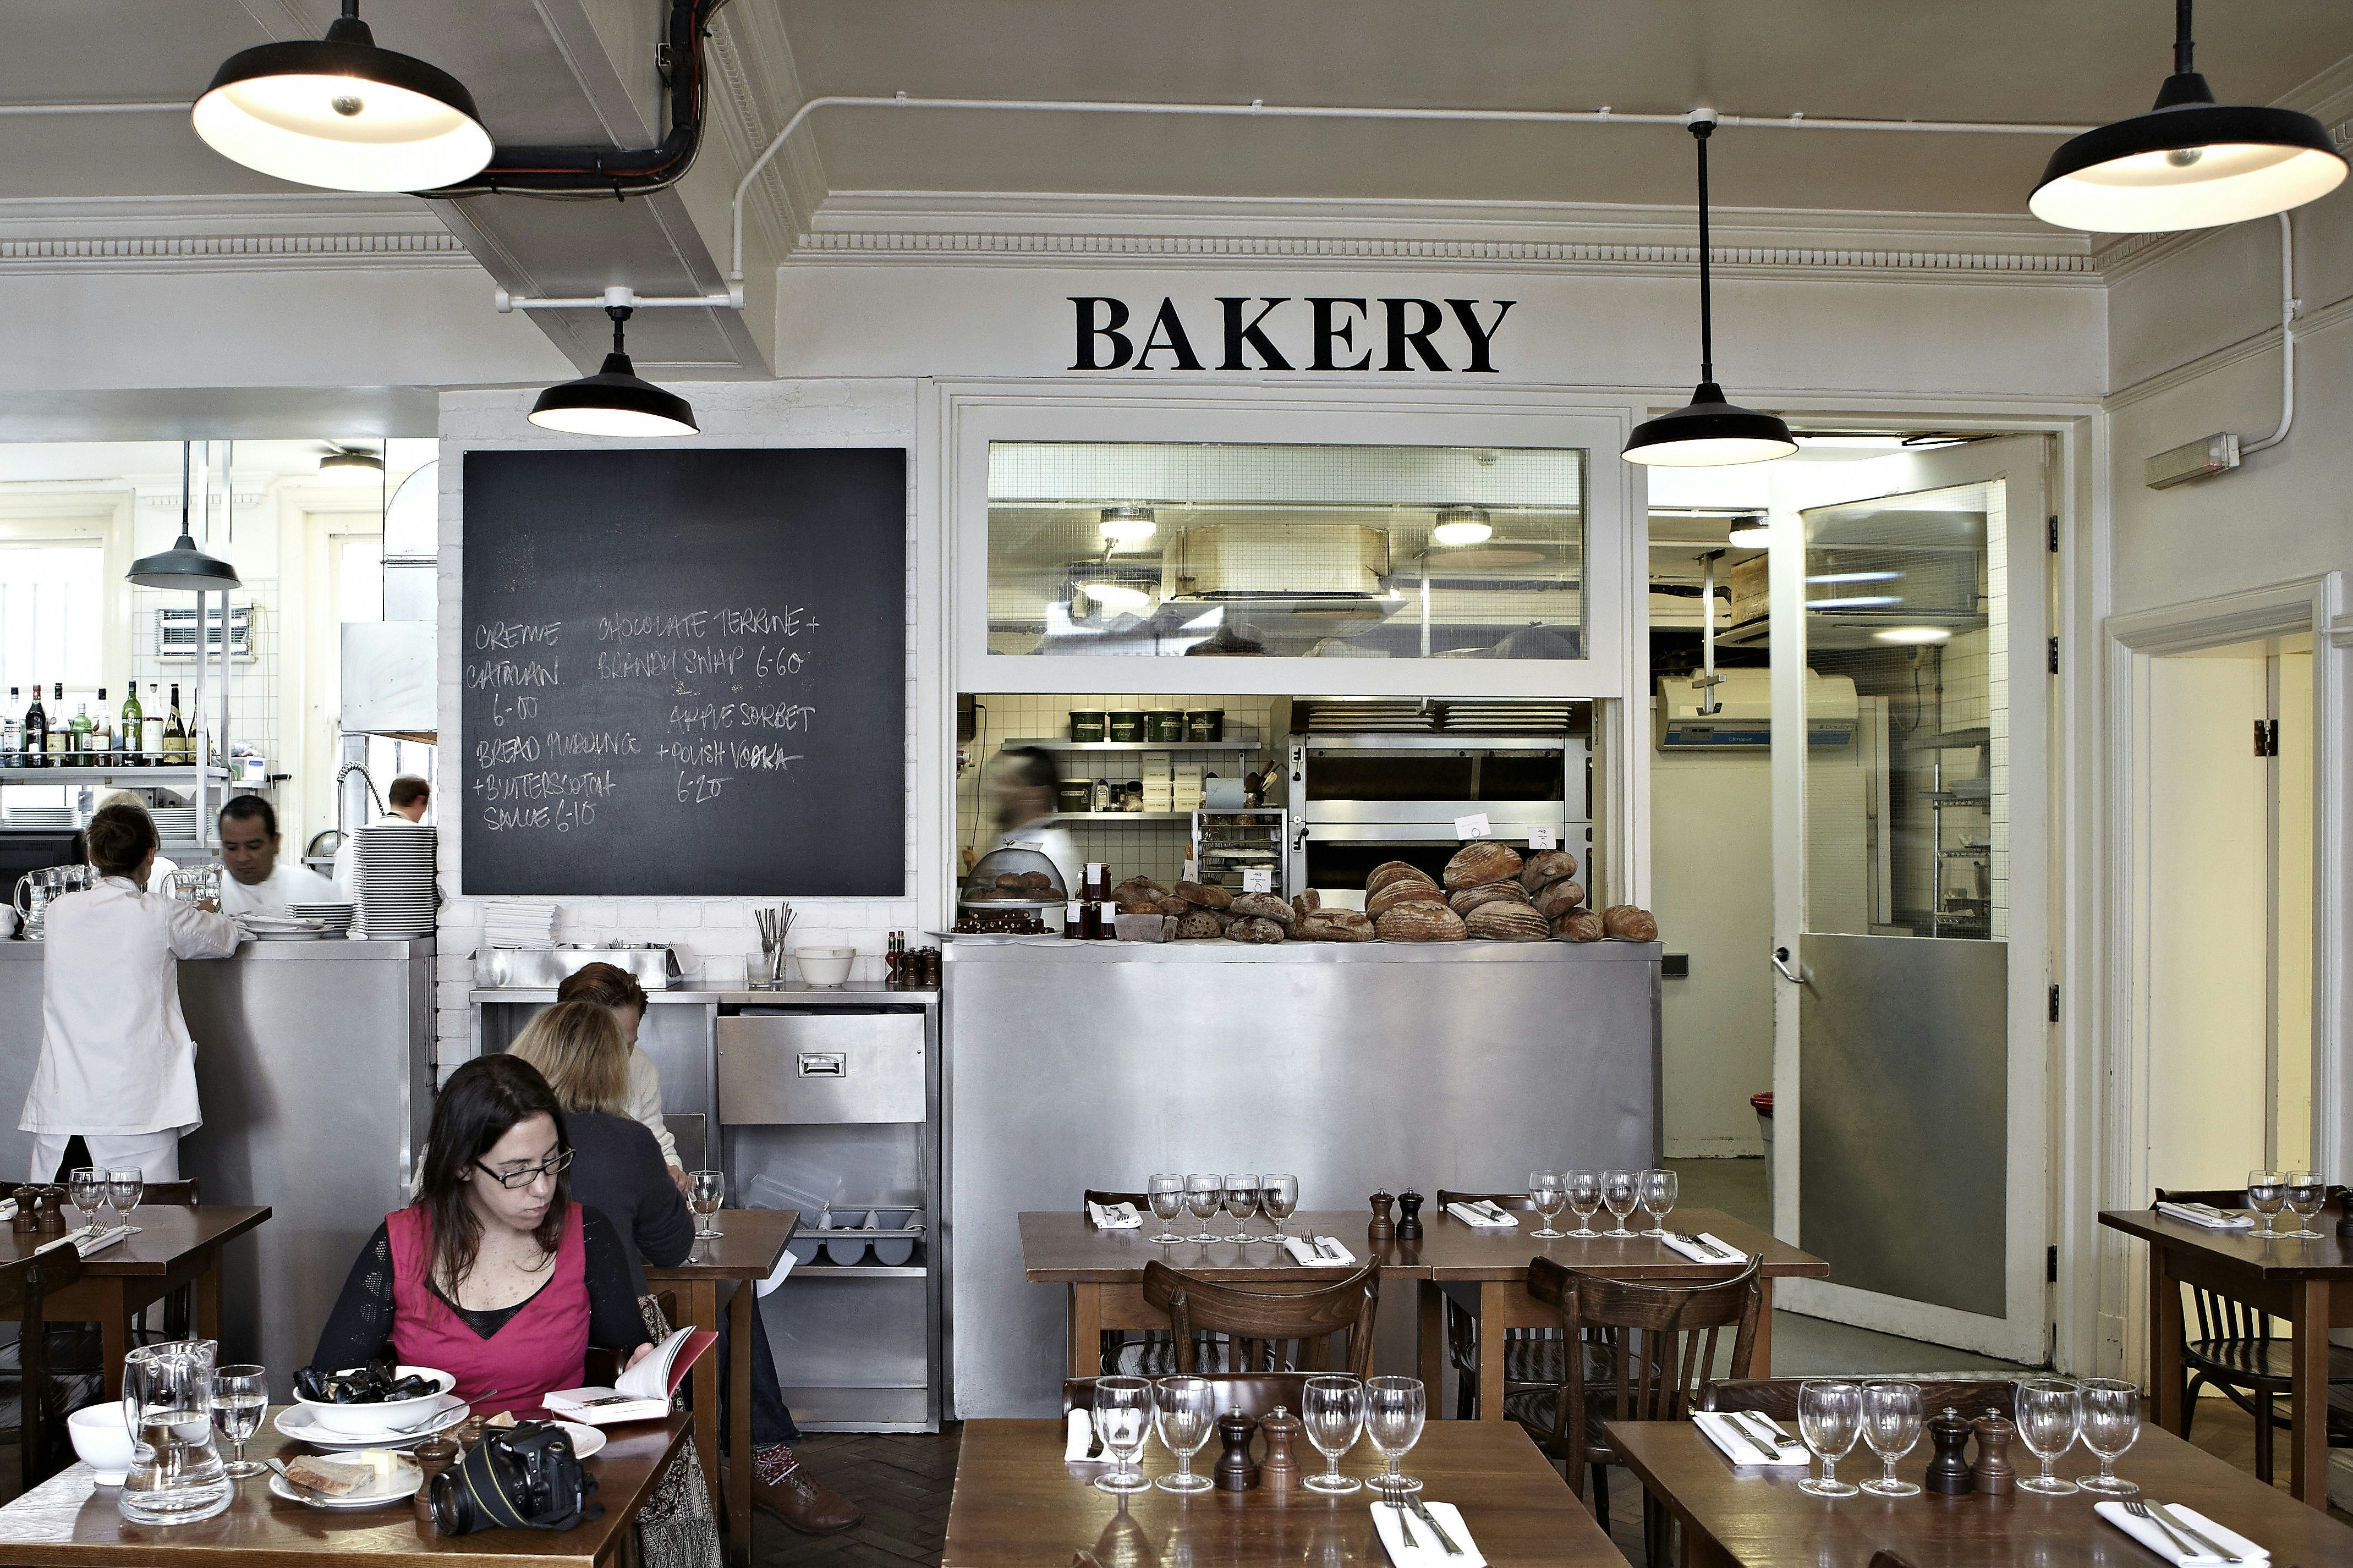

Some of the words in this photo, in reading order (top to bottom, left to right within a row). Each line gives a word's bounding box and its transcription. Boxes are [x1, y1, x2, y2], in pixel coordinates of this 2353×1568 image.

[1066, 296, 1517, 373] BAKERY
[476, 620, 562, 650] CREME
[598, 610, 709, 644] CHOCOLATE
[713, 605, 804, 637] TERRINE
[597, 648, 677, 680] BRANDY
[684, 645, 744, 675] SNAP
[670, 703, 735, 733] APPLE
[740, 701, 816, 733] SORBET
[476, 735, 541, 769] BREAD
[547, 730, 641, 761] PUDDING
[730, 739, 804, 771] VODKA
[483, 806, 551, 832] SAUCE
